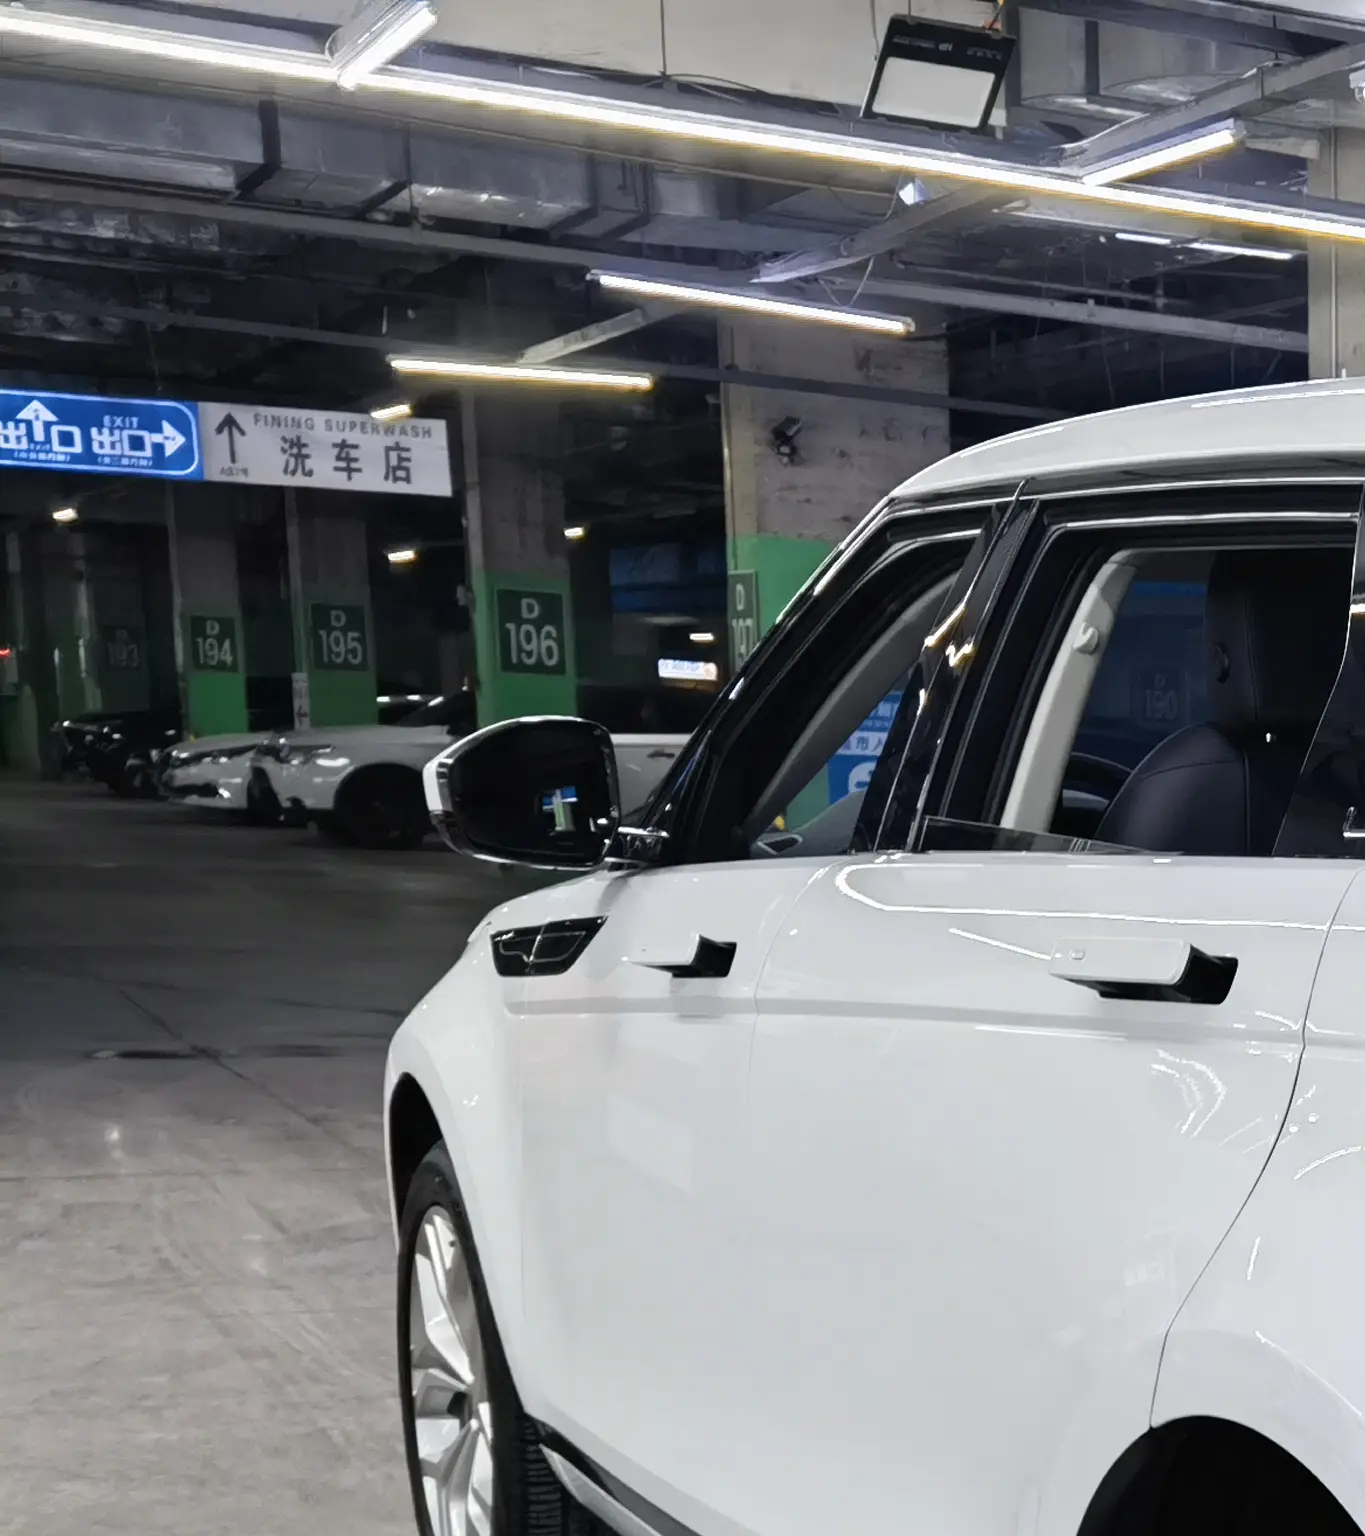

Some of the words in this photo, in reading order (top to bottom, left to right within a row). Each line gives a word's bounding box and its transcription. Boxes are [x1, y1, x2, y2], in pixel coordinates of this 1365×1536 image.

[103, 415, 139, 428] EXIT
[324, 418, 433, 439] SUPERWASH
[90, 427, 153, 457] 出口
[279, 434, 413, 485] 洗车店
[521, 598, 540, 619] D
[735, 583, 745, 611] D
[206, 620, 220, 636] D
[330, 609, 346, 627] D
[195, 637, 233, 668] 194
[318, 630, 363, 665] 195
[505, 623, 559, 666] 196
